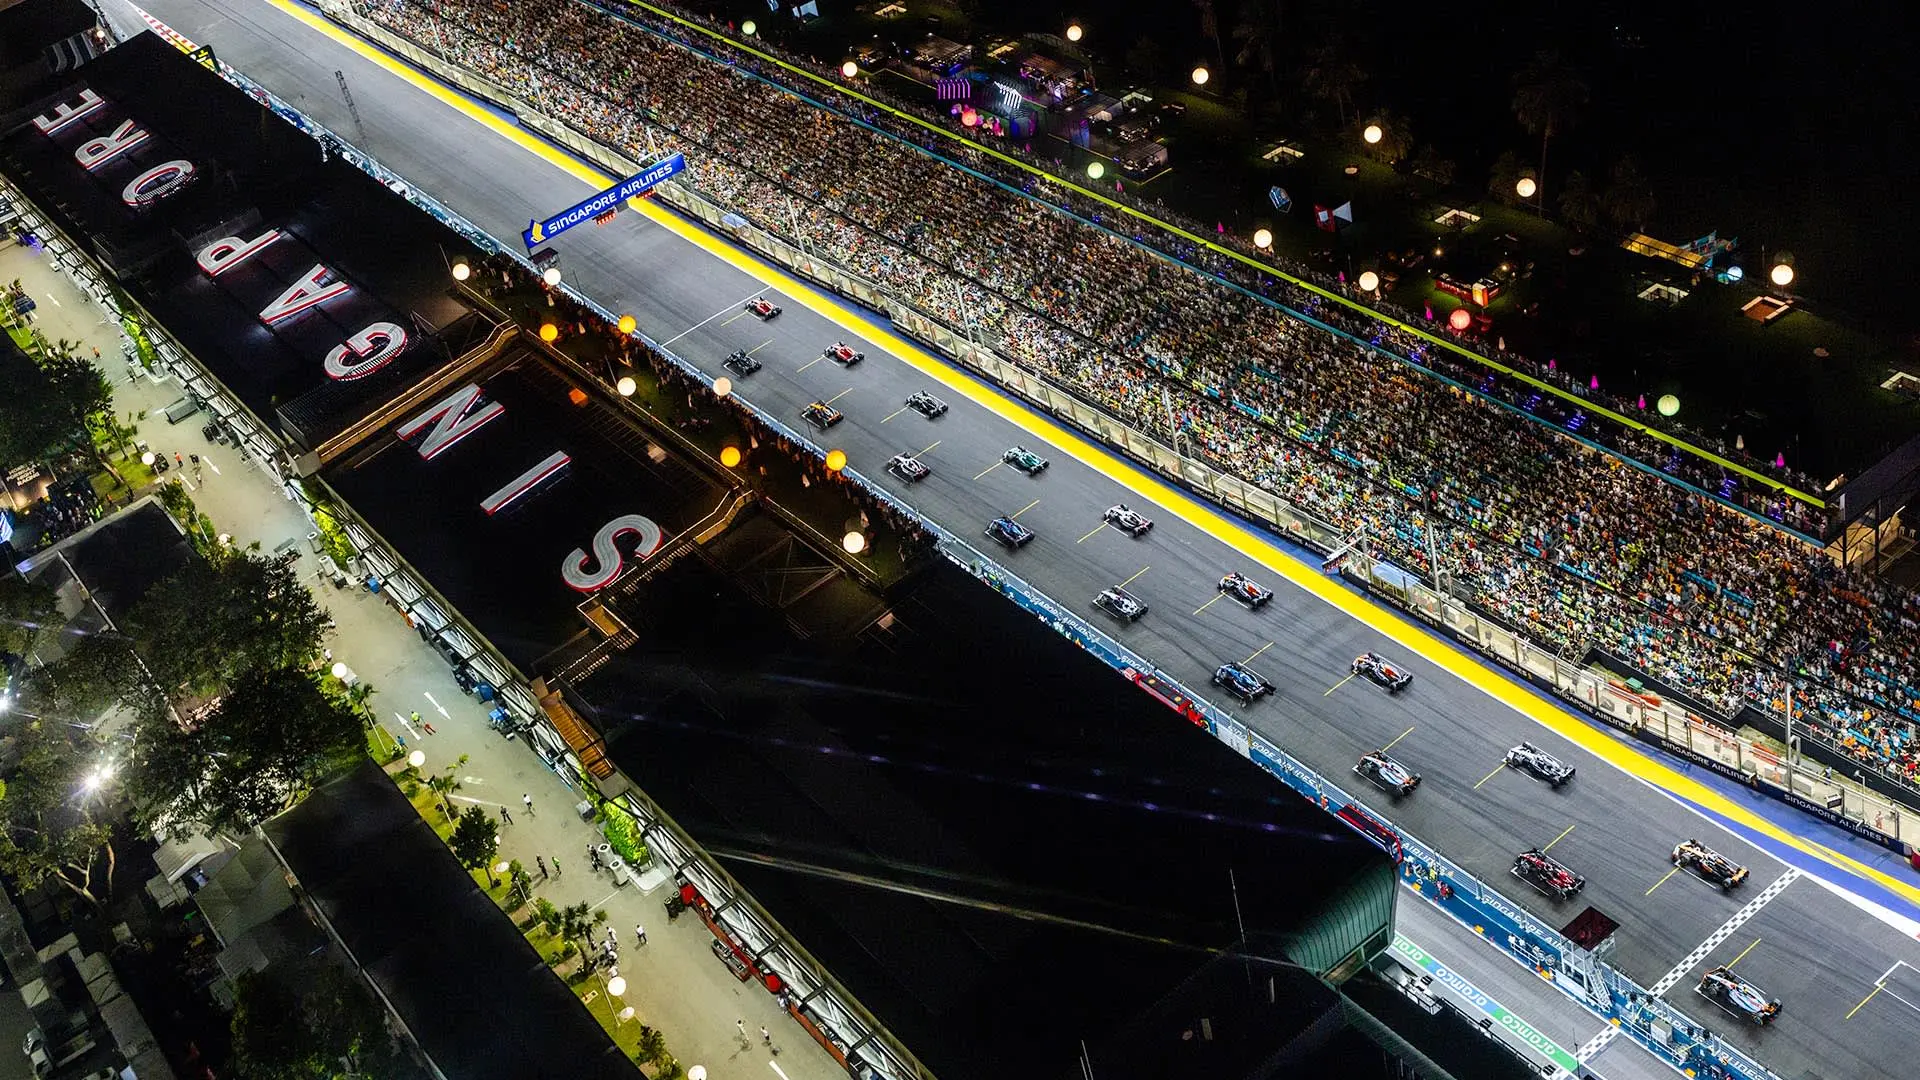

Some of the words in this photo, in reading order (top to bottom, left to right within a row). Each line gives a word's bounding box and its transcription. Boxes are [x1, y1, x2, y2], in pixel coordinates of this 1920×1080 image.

[548, 192, 618, 234] SINGAPORE
[620, 163, 674, 198] AIRLINES
[33, 86, 664, 593] SINGAPORE
[1456, 633, 1496, 660] SINGAPORE
[1495, 655, 1528, 677] AIRLINES
[1660, 739, 1710, 767] SINGAPORE
[1711, 762, 1750, 783] AIRLINES
[1784, 793, 1837, 821] SINGAPORE
[1838, 818, 1882, 842] AILINES
[1393, 935, 1424, 961] aram
[1435, 967, 1488, 1007] aramco
[1501, 1015, 1556, 1056] aramco
